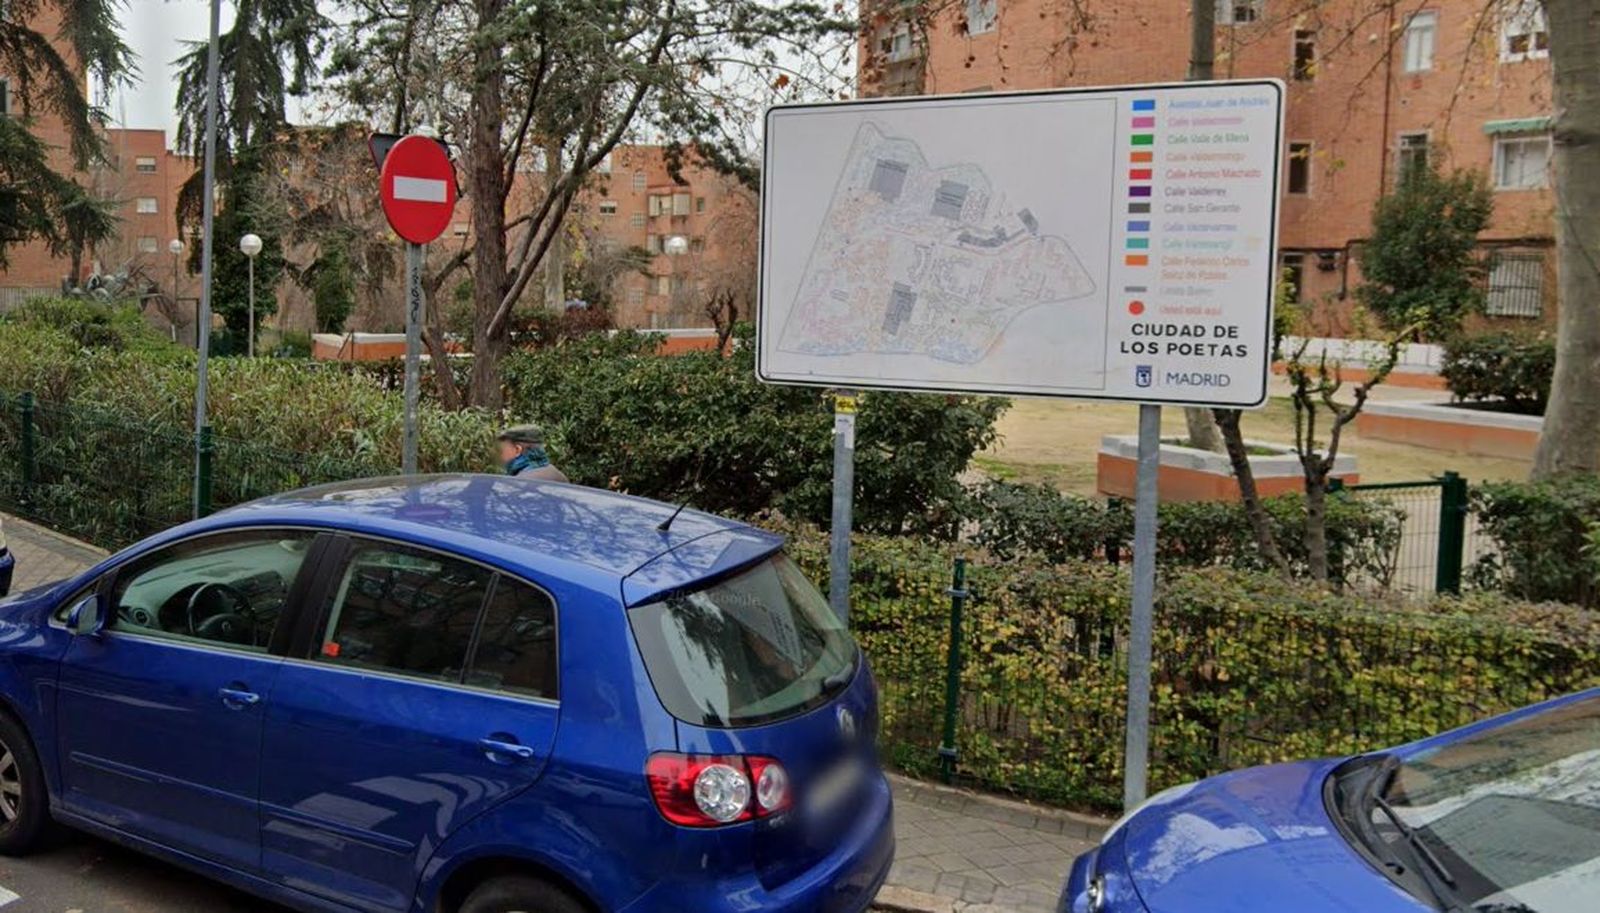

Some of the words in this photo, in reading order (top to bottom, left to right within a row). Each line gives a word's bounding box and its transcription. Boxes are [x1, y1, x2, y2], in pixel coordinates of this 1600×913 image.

[1168, 134, 1189, 144] Calle
[1214, 133, 1223, 143] de
[1165, 169, 1186, 179] Calle
[1164, 187, 1185, 197] Calle
[1164, 204, 1184, 213] Calle
[1161, 256, 1182, 267] Calle
[1131, 323, 1206, 338] CIUDAD
[1213, 325, 1239, 339] DE
[1120, 341, 1159, 355] LOS
[1166, 343, 1248, 358] POETAS
[1166, 372, 1231, 387] MADRID
